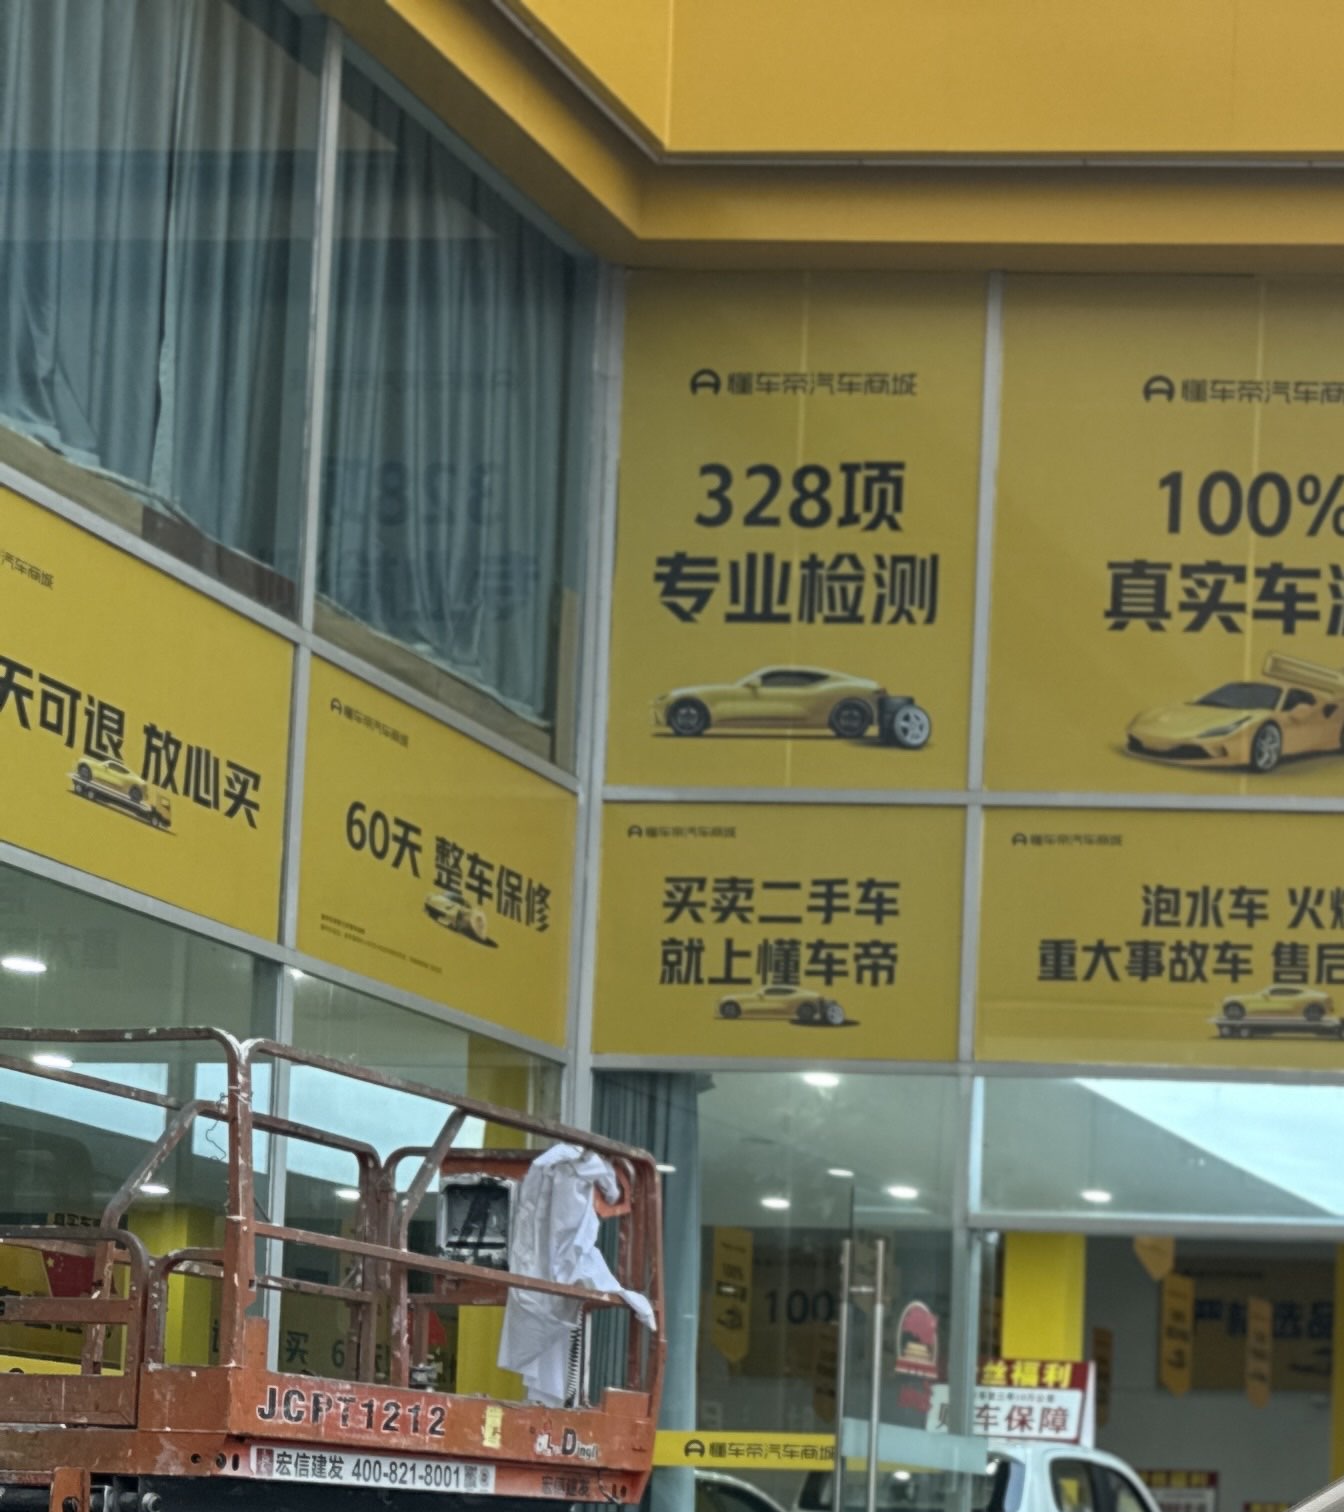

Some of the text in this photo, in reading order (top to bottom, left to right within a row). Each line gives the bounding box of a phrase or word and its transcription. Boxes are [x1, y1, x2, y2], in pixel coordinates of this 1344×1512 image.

[694, 460, 906, 532] 328项
[653, 551, 939, 625] 专业检测
[0, 653, 262, 830] 天可退 放心买
[346, 800, 552, 933] 60天 整车保修
[662, 876, 901, 926] 买卖二手车
[1141, 884, 1270, 929] 泡水车
[659, 937, 899, 987] 就上懂车帝
[1036, 938, 1254, 984] 重大事故车
[256, 1386, 447, 1437] JCPT1212
[276, 1450, 460, 1489] 宏信建发 400-821-8001
